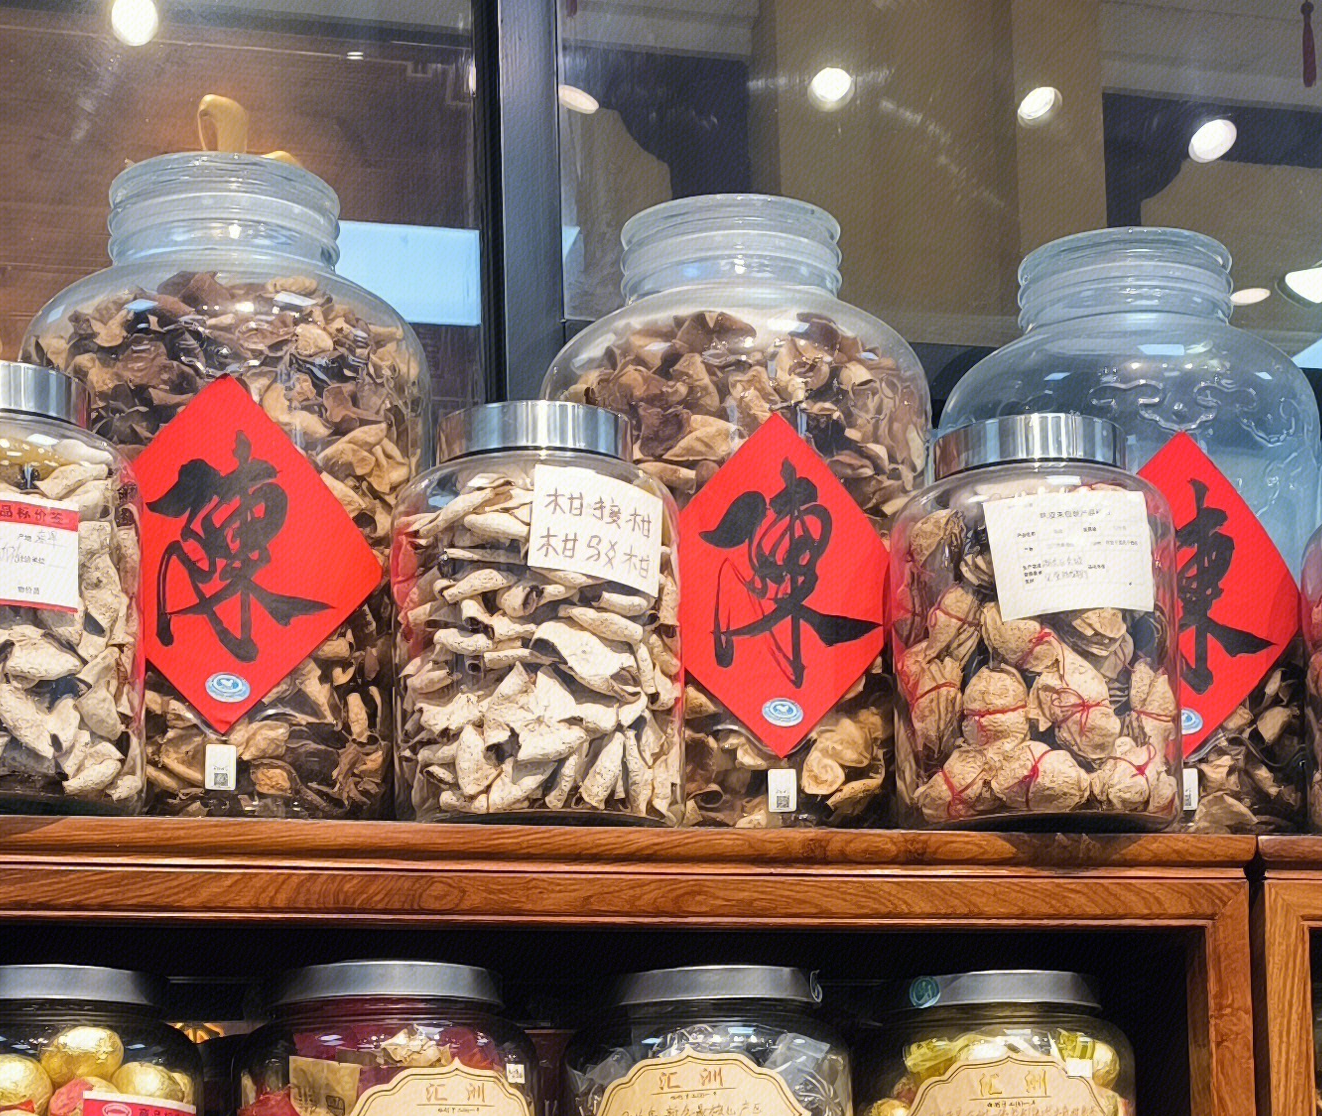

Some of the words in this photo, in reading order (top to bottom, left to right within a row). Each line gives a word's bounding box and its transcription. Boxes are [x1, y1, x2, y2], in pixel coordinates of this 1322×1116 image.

[145, 429, 337, 663] 陳
[700, 457, 883, 688] 陳
[426, 1082, 486, 1103] 汇洲
[659, 1067, 724, 1091] 汇洲
